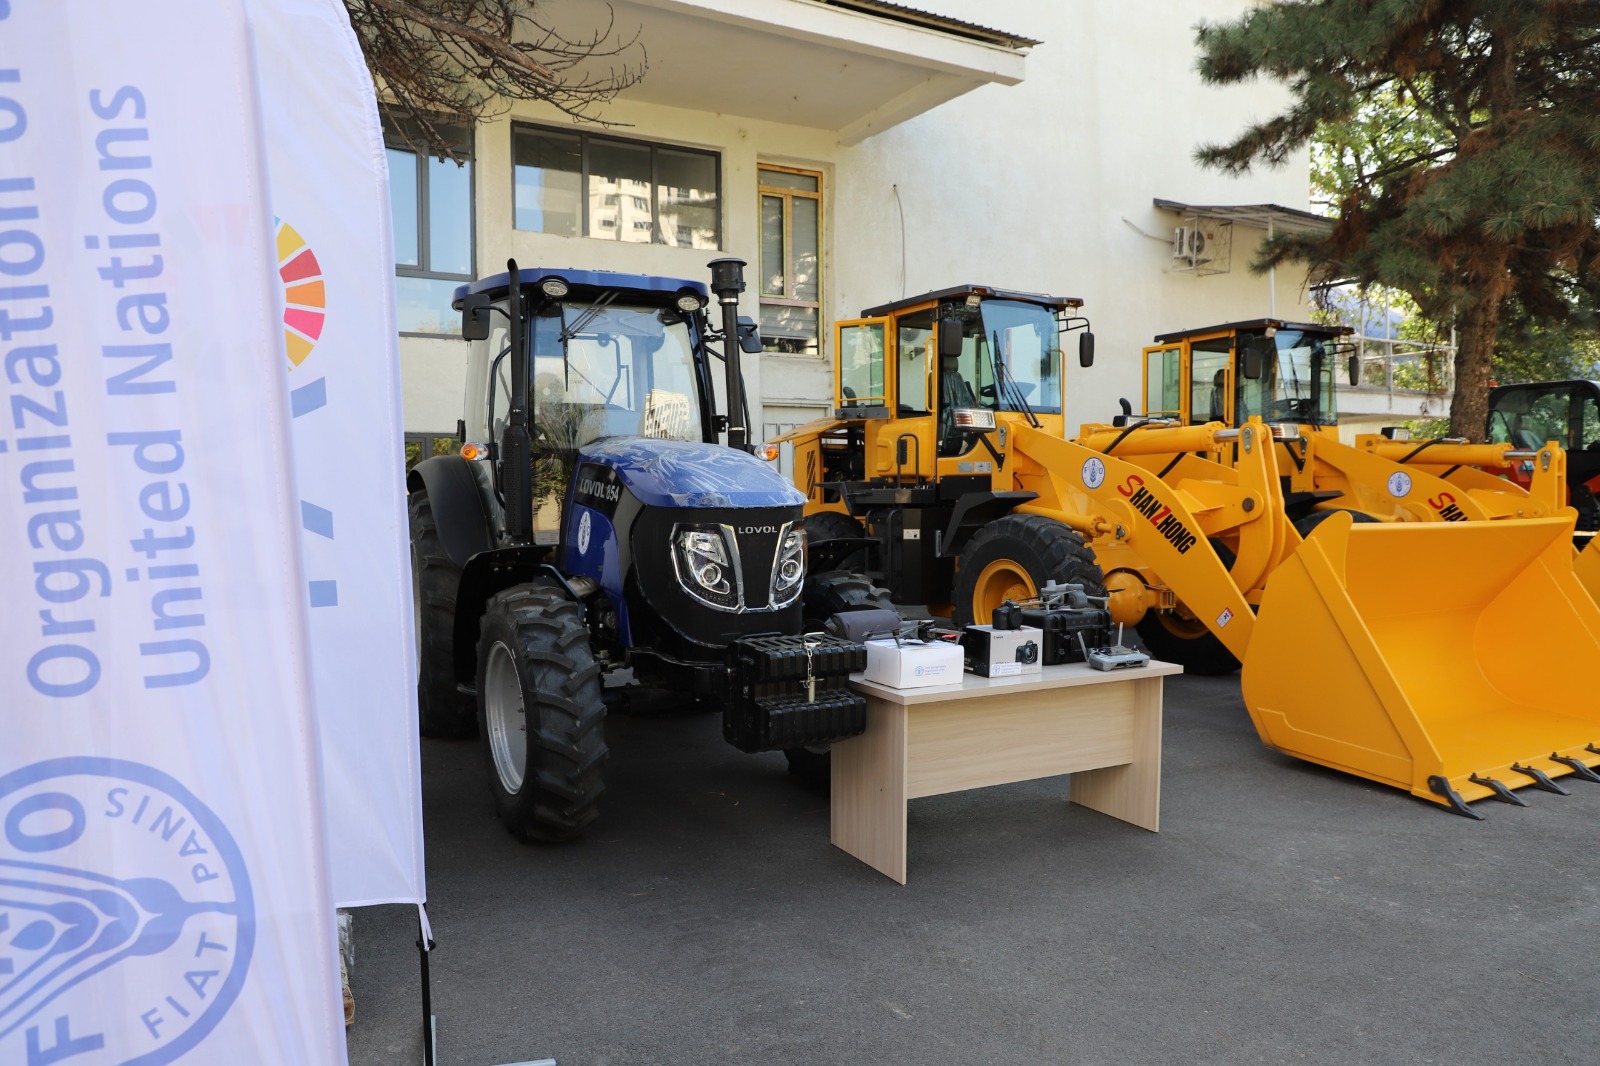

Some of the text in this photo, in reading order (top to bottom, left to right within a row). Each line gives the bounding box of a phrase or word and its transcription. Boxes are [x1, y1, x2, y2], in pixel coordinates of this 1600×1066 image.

[0, 177, 113, 698] Organization
[84, 84, 210, 689] United Nations
[579, 478, 620, 502] LOVOL 854
[738, 525, 778, 535] LOVOL
[1117, 474, 1197, 555] SHANZHONG
[105, 787, 229, 1040] FIAT PANIS
